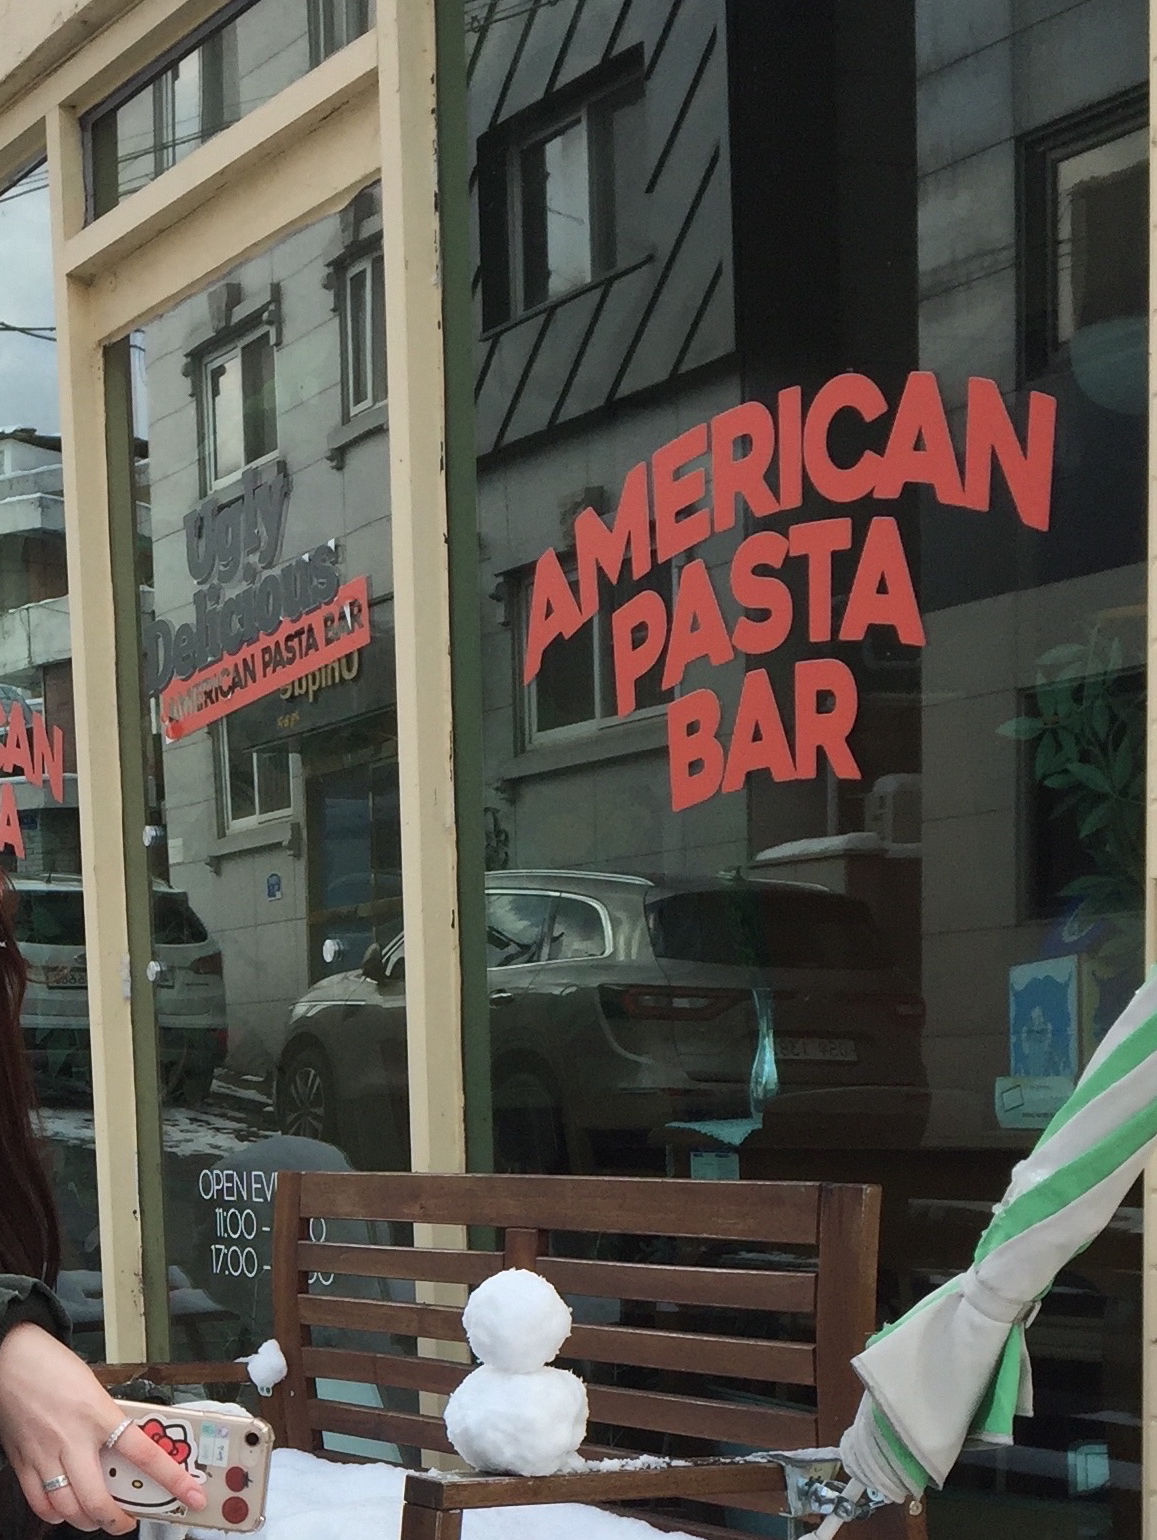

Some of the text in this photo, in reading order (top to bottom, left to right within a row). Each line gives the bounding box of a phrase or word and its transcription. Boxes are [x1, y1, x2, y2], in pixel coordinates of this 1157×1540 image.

[184, 462, 291, 584] Ugly
[524, 371, 1057, 683] AMERICAN
[142, 540, 340, 694] Delicious
[261, 622, 319, 679] PASTA
[323, 598, 364, 647] BAR
[612, 517, 926, 716] PASTA
[667, 658, 861, 811] BAR
[198, 1169, 247, 1200] OPEN
[215, 1207, 257, 1240] 11:00
[210, 1244, 258, 1278] 17:00
